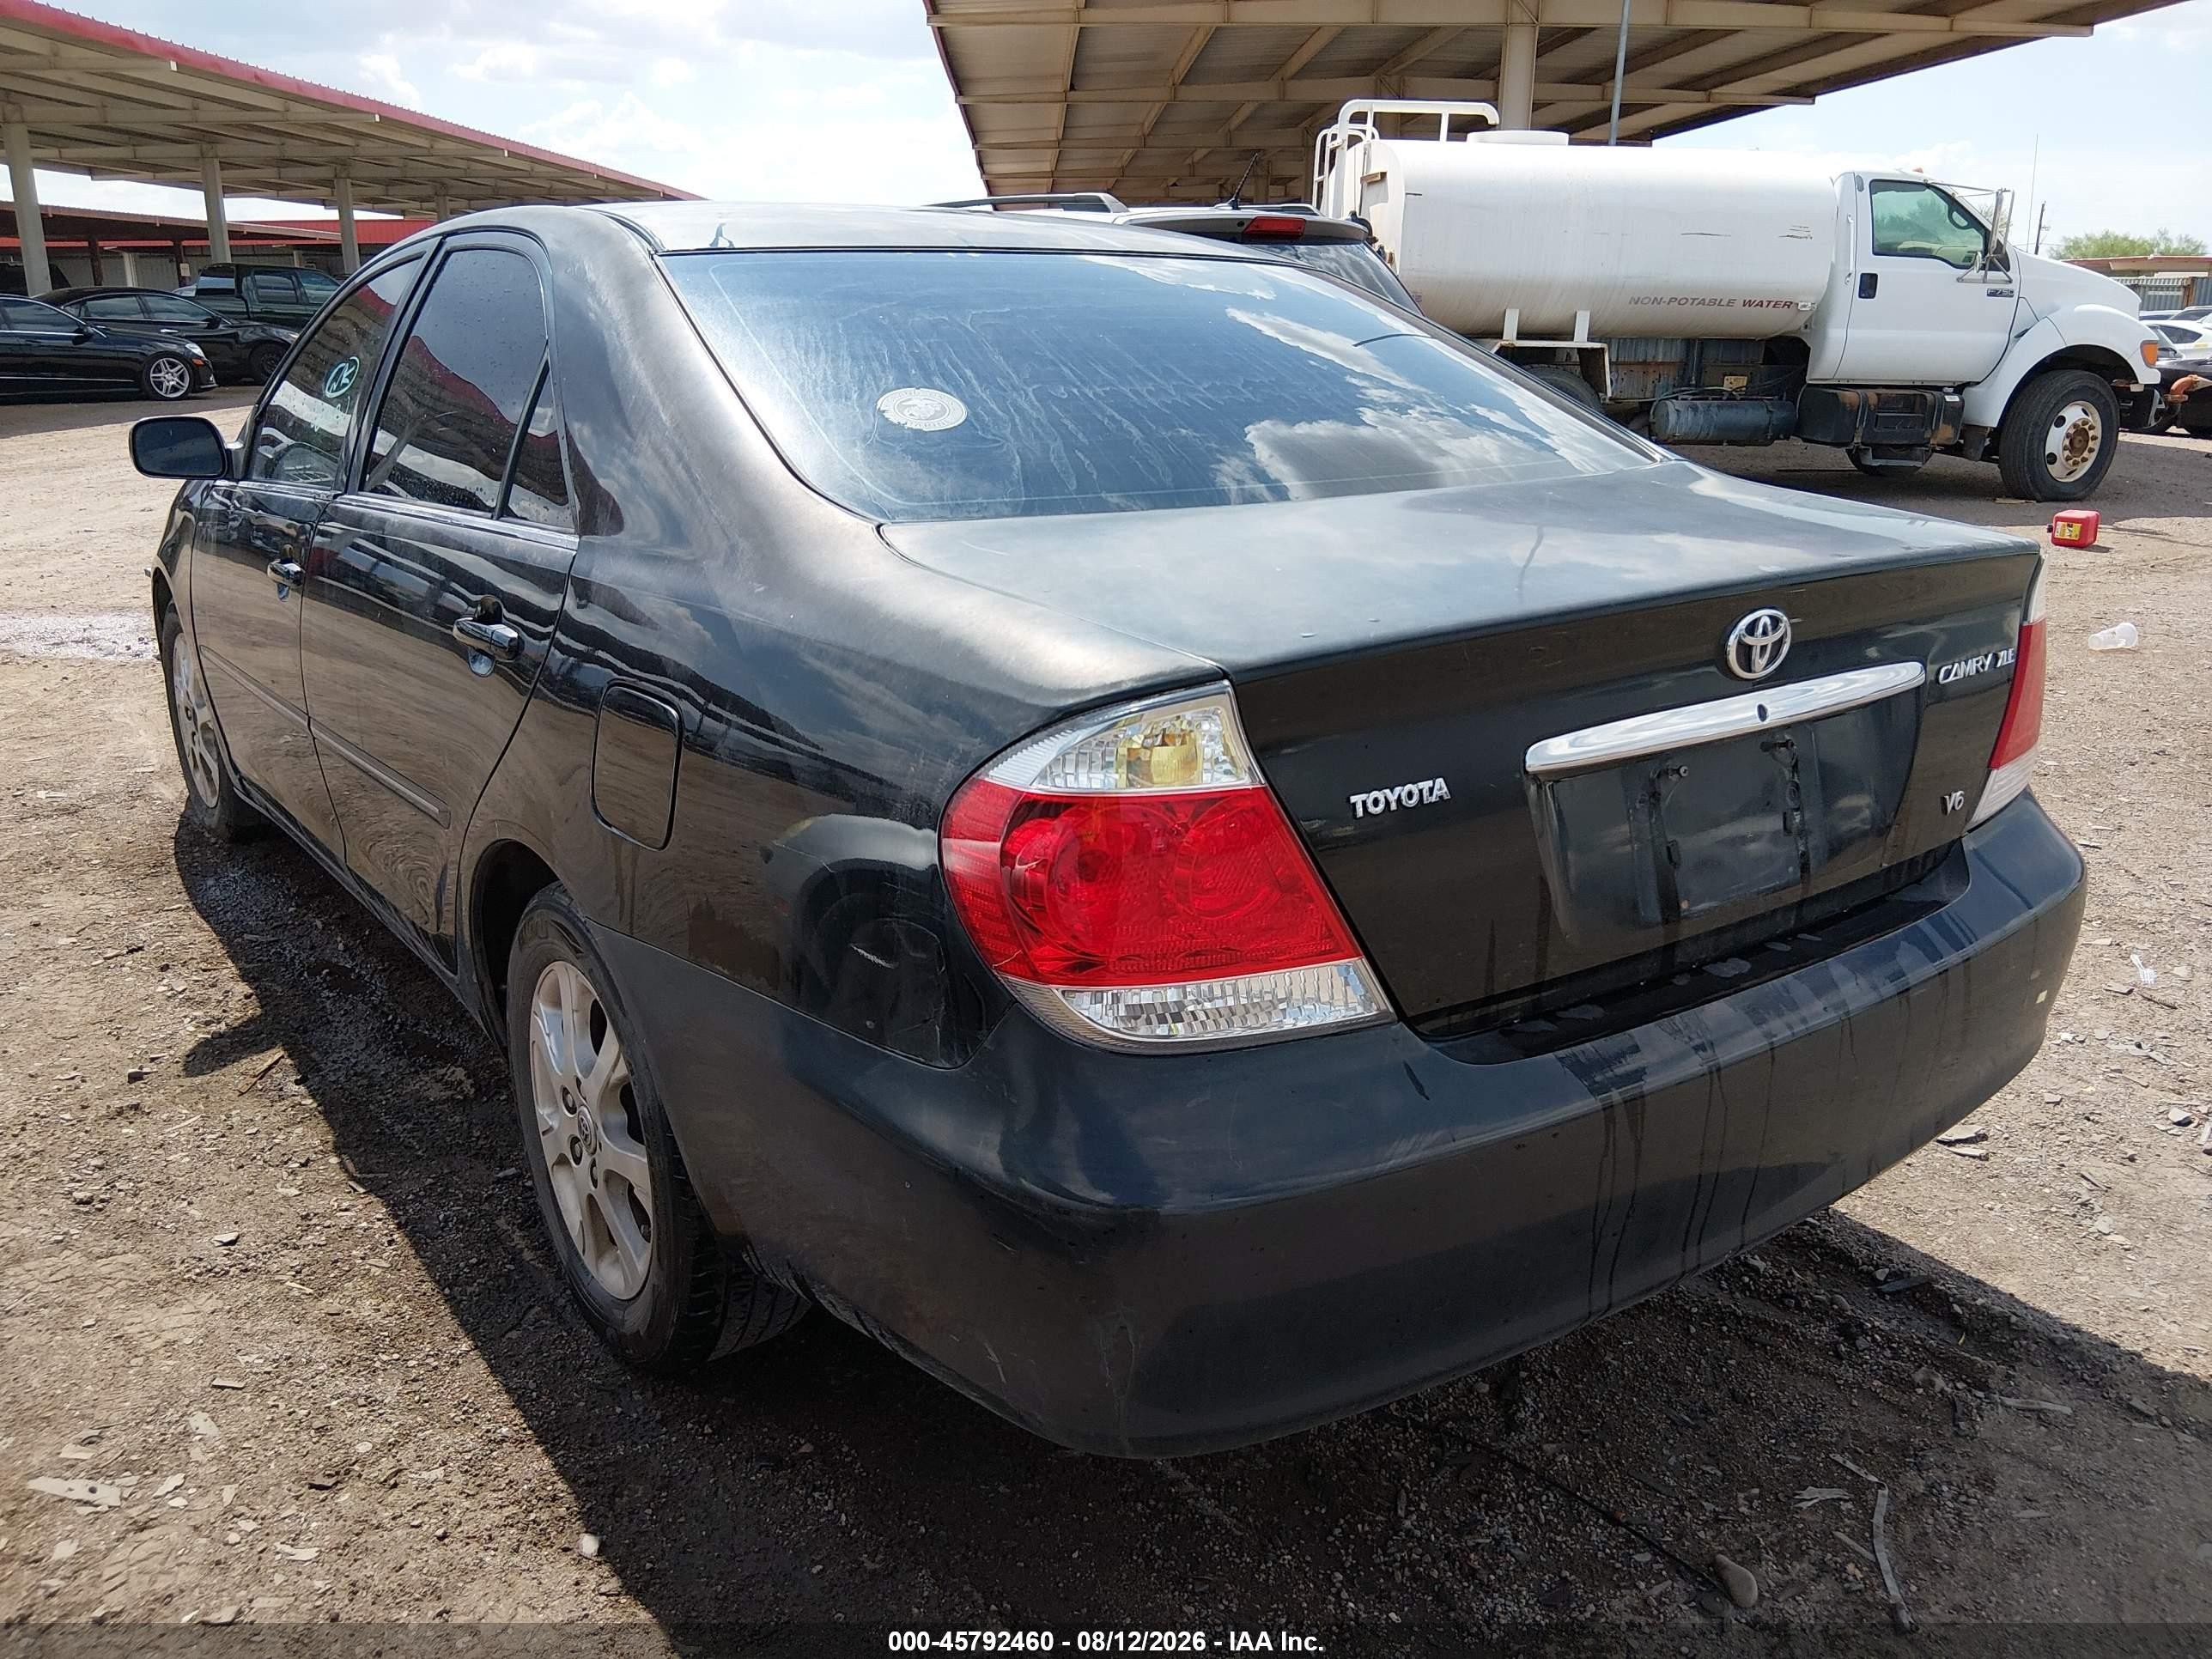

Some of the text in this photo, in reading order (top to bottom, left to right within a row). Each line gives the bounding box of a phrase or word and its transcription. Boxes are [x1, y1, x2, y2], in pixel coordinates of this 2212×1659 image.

[1628, 296, 1736, 307] NON-POTABLE
[1741, 299, 1794, 308] WATER
[1939, 653, 1993, 684] CAMRY
[1349, 777, 1451, 818] TOYOTA
[1942, 790, 1965, 816] V6
